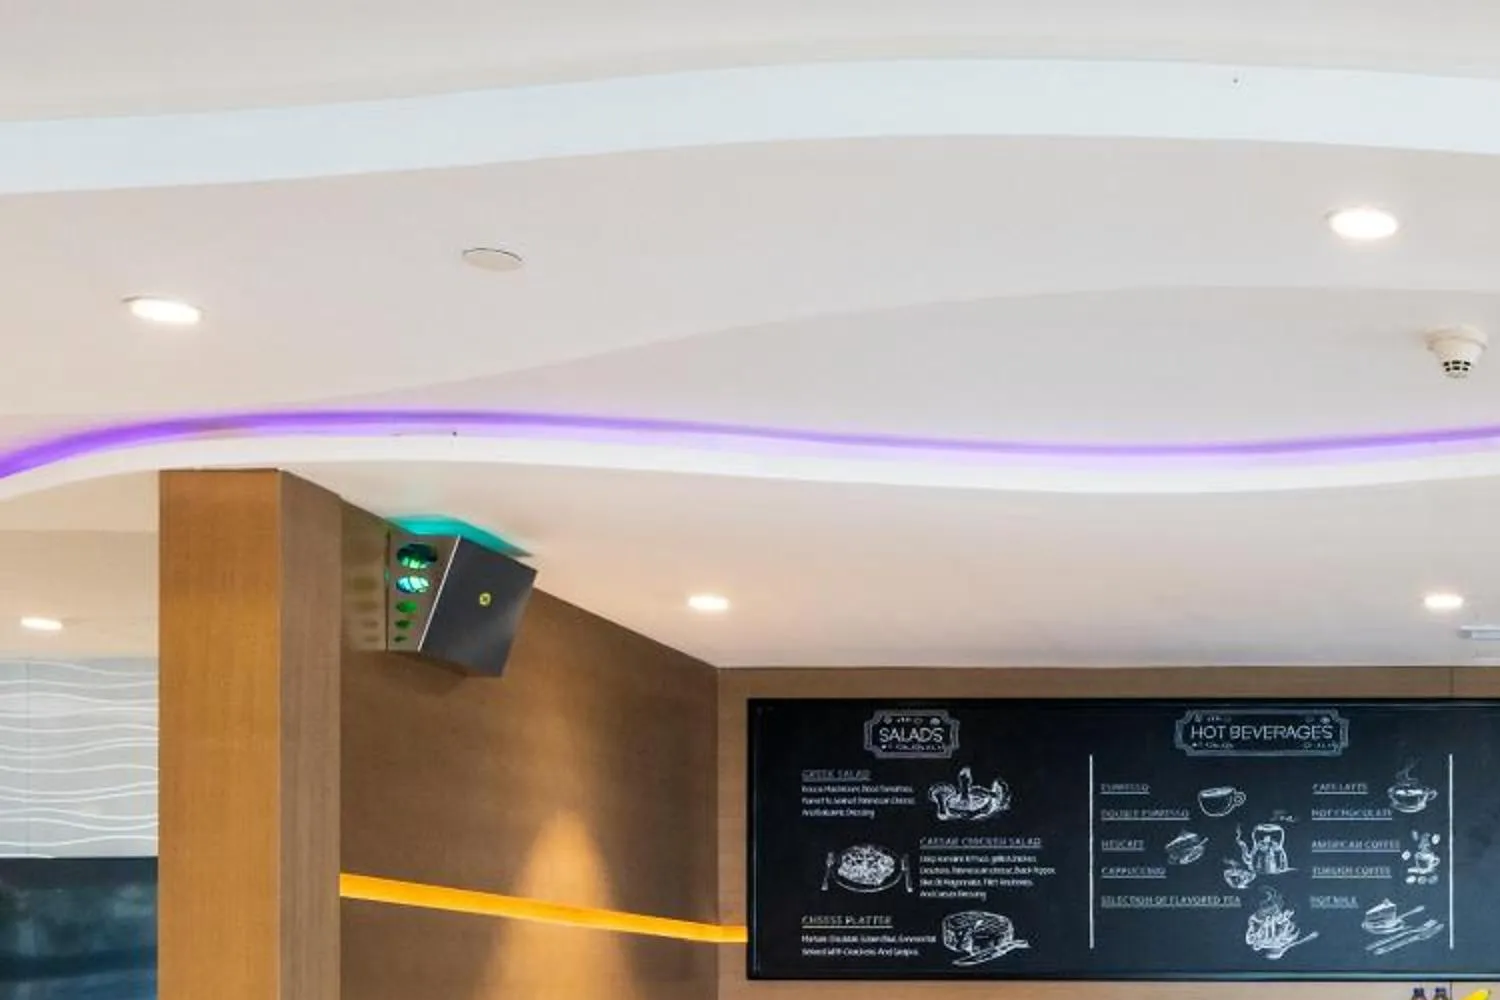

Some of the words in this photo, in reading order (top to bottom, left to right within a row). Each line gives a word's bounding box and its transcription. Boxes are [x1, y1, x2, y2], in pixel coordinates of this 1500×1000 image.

[879, 727, 944, 743] SALADS
[1191, 725, 1227, 740] HOT
[1229, 725, 1334, 740] BEVERAGES
[1100, 783, 1150, 792] ESPRESSO
[1142, 809, 1190, 818] ESPRESSO
[1311, 808, 1331, 817] HOT
[1332, 808, 1392, 817] CHOCOLATE
[1009, 837, 1041, 846] SALAD
[1311, 840, 1363, 849] AMERICAN
[1364, 840, 1401, 849] COFFEE
[1101, 867, 1167, 876] CAPPUCCINO
[1355, 866, 1391, 875] COFFEE
[1101, 895, 1153, 905] SELECTION
[1155, 895, 1168, 905] OF
[1169, 895, 1221, 905] FLAVORED
[1223, 895, 1242, 905] TEA
[801, 915, 843, 925] CHEESE
[845, 915, 892, 925] PLATTER
